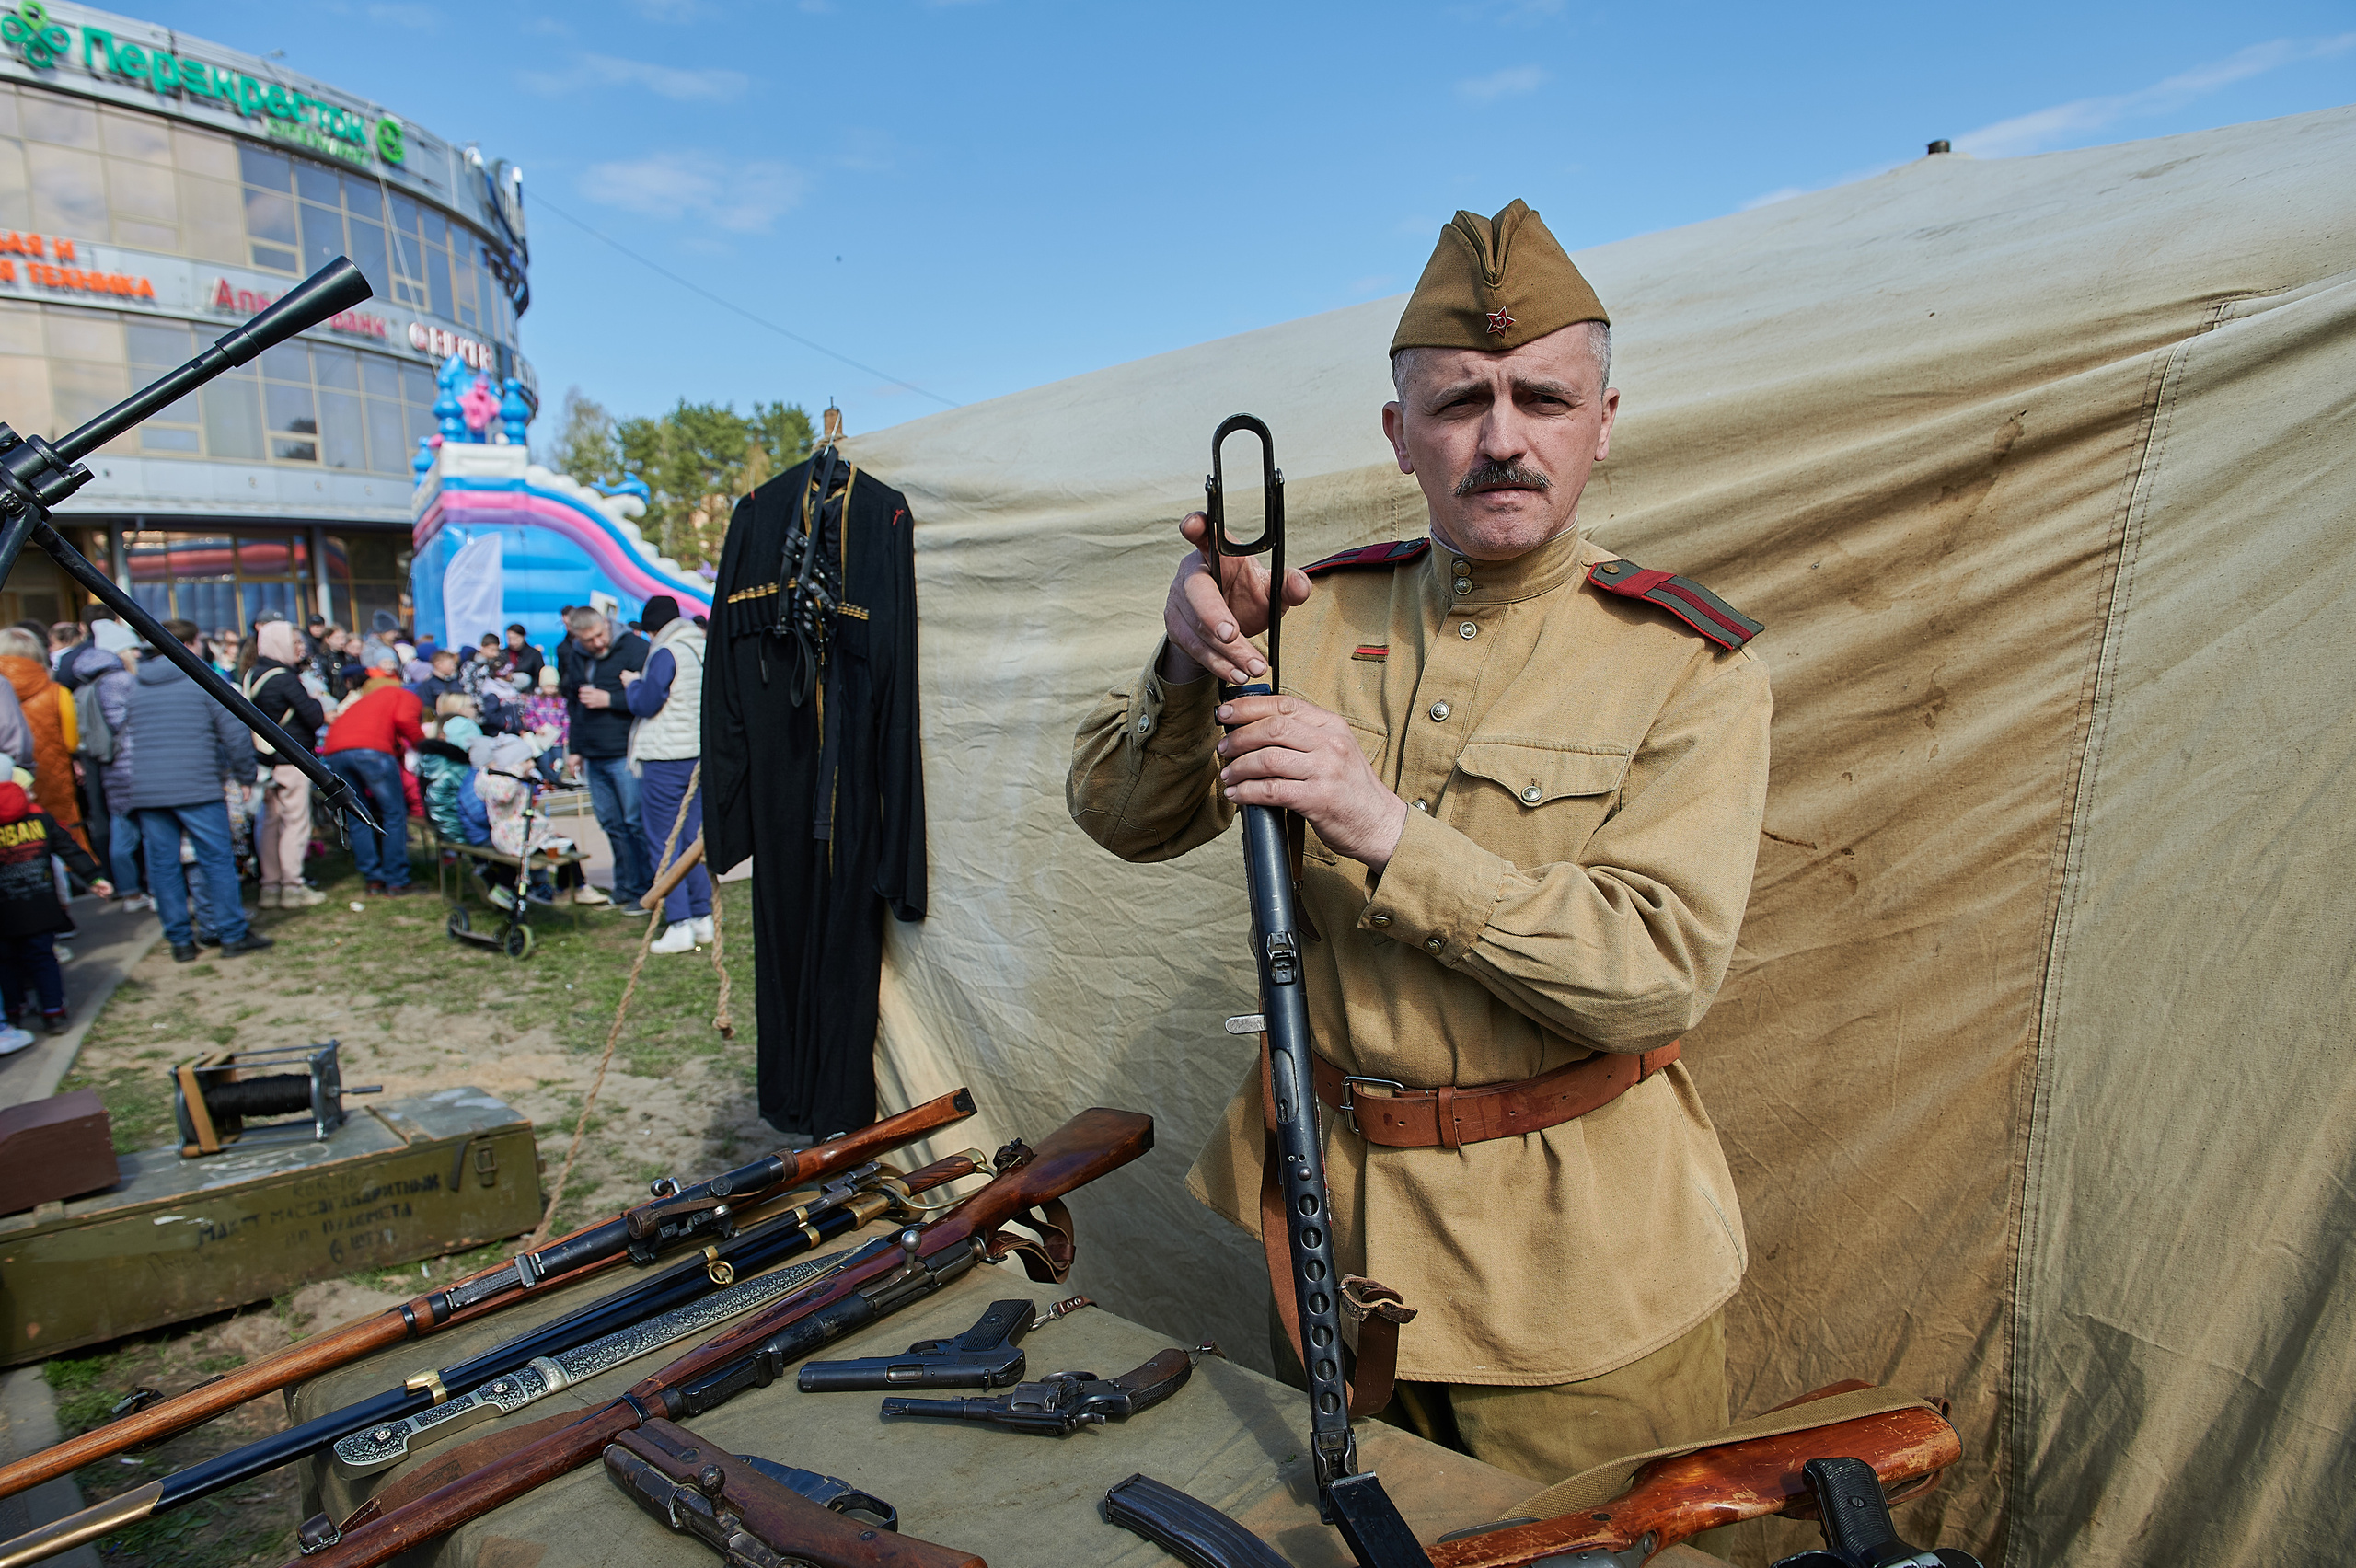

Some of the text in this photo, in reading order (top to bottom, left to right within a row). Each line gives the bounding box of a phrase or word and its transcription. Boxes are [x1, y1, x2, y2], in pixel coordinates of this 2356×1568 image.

[26, 261, 156, 299] ТЕХНИКА
[210, 275, 287, 315] Аль
[329, 1238, 344, 1264] 6
